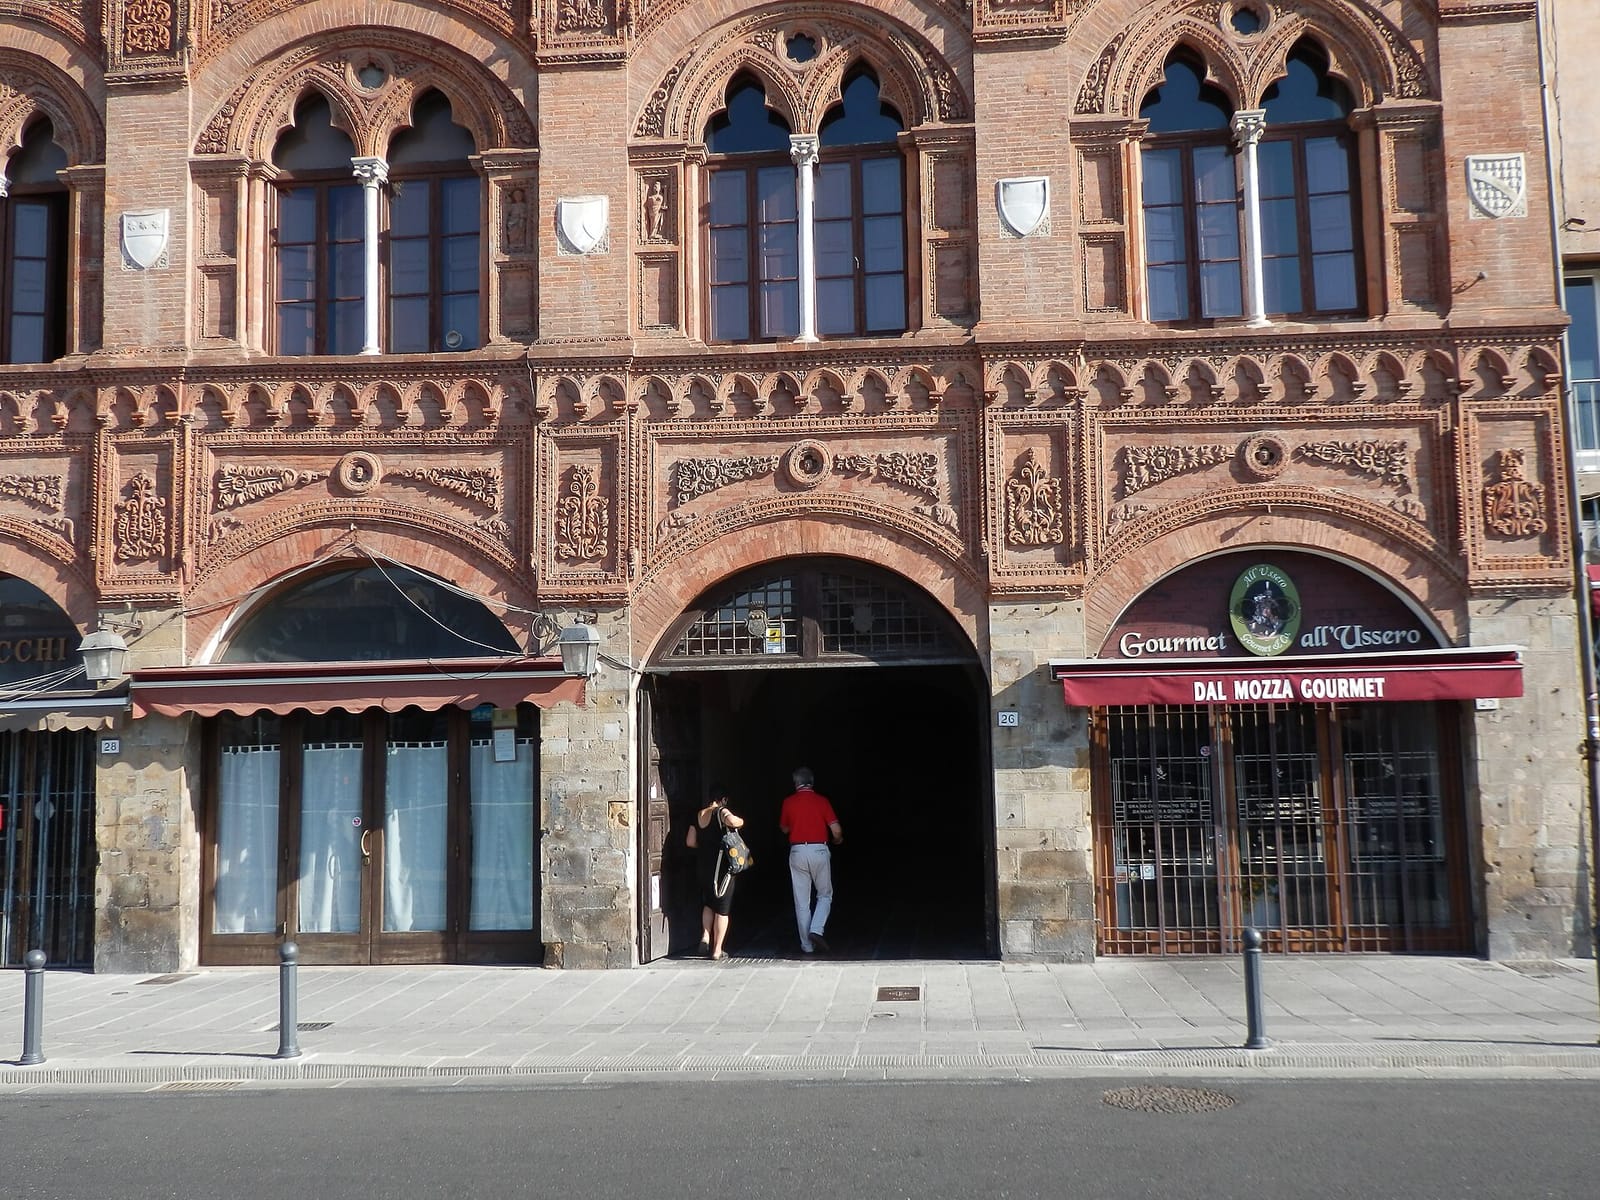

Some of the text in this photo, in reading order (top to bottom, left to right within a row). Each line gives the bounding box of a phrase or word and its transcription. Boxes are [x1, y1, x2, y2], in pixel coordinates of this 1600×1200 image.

[1120, 632, 1227, 657] Gourmet
[1301, 625, 1420, 650] all'Ussero
[0, 637, 67, 663] CCHI
[1193, 677, 1385, 701] DAL MOZZA GOURMET
[1001, 714, 1015, 724] 26
[104, 742, 116, 751] 28
